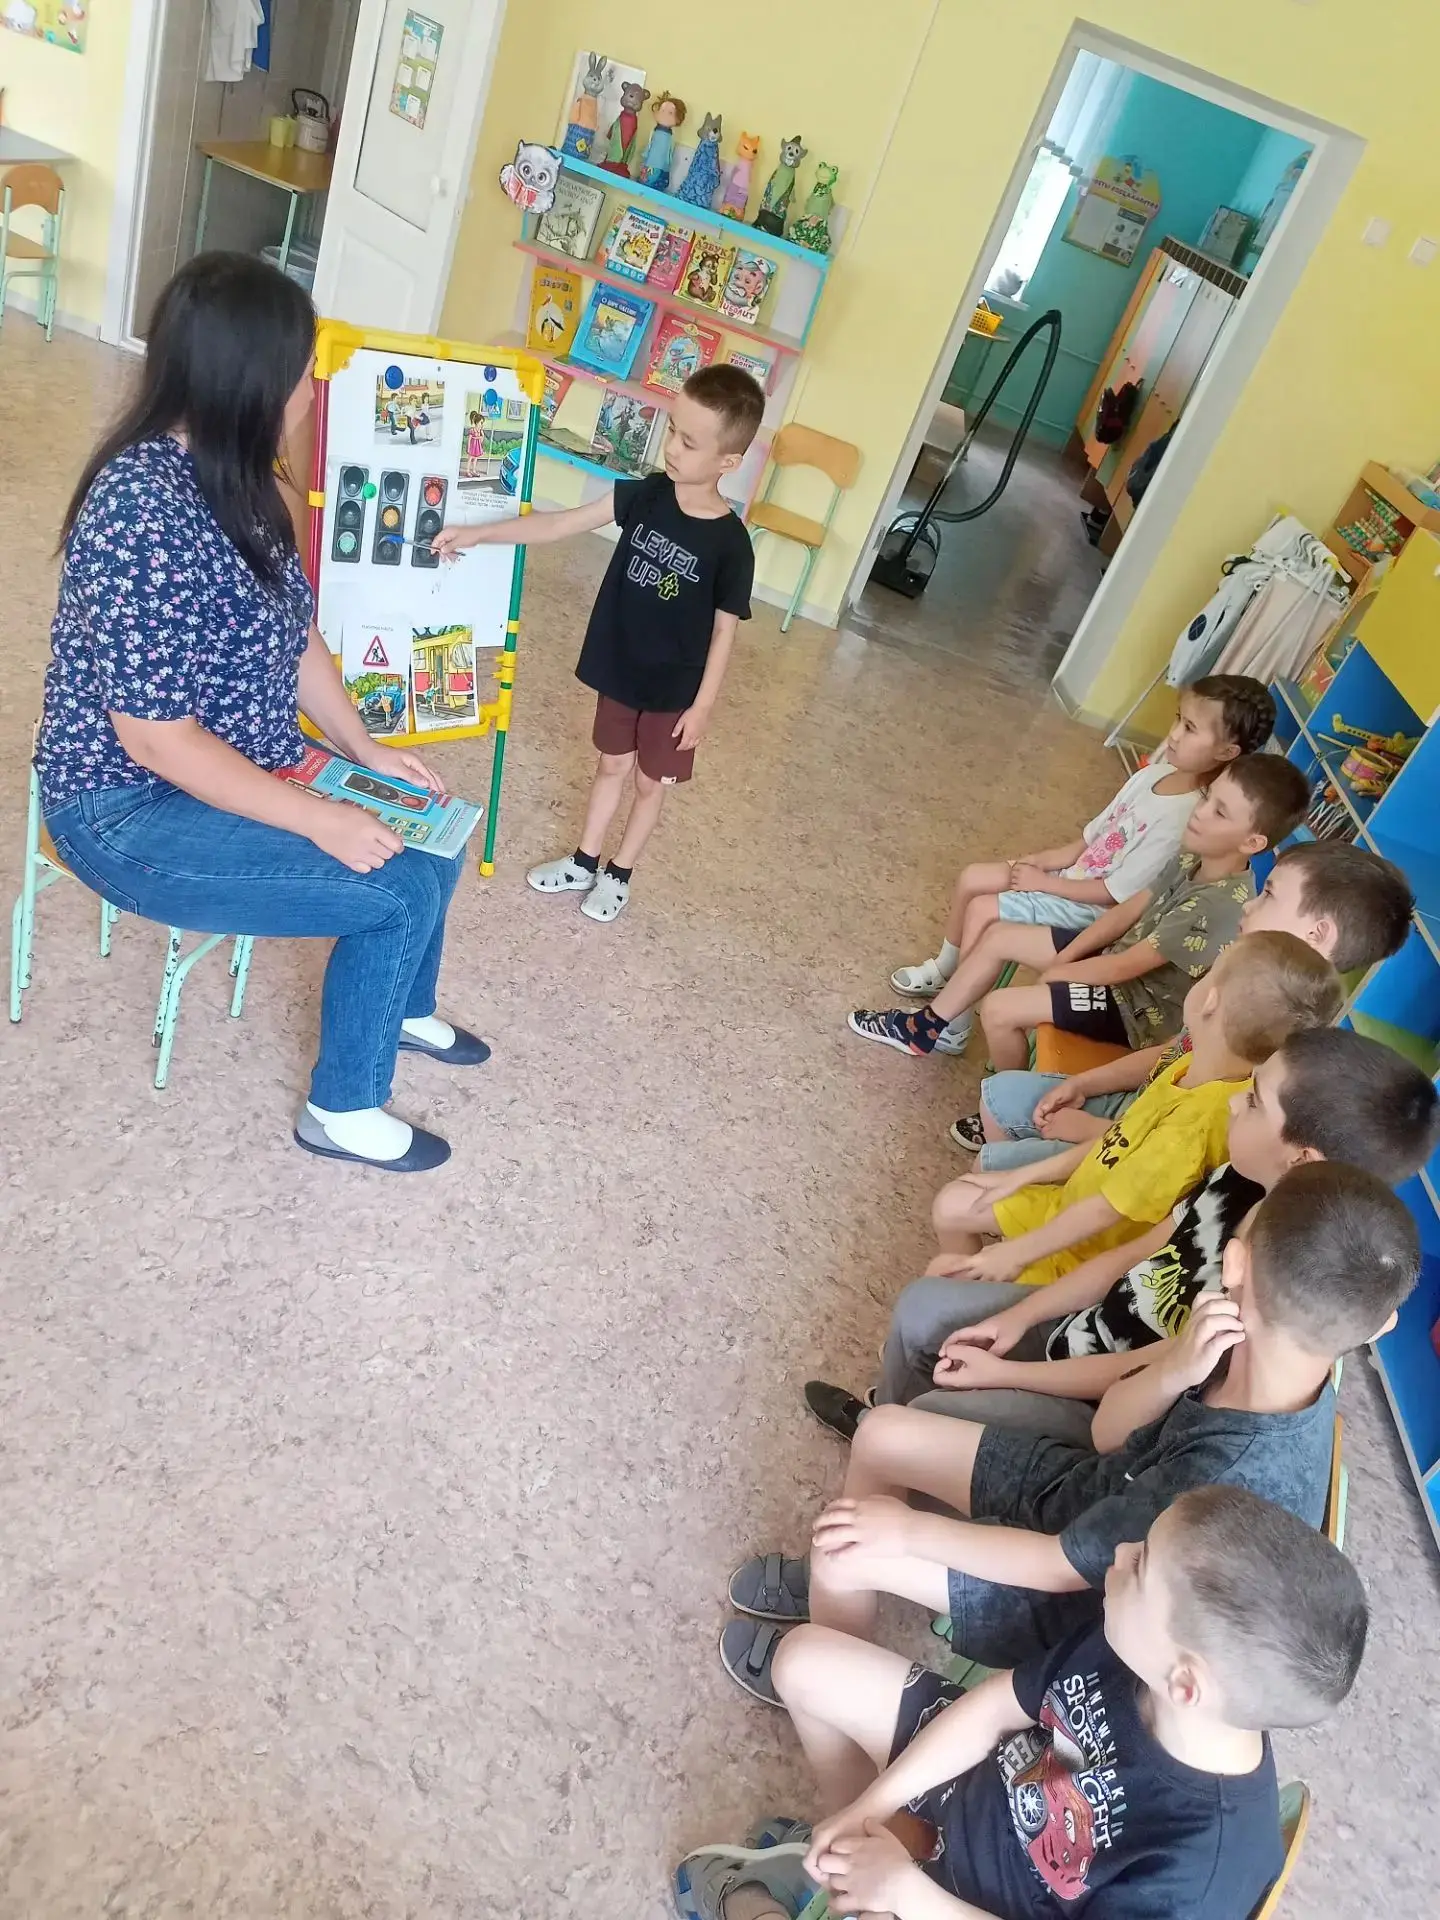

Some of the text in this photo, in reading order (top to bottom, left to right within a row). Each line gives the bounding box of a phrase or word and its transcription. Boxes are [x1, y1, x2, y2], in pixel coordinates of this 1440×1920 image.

[627, 555, 661, 587] UP
[631, 523, 700, 582] LEVEL
[1089, 1690, 1111, 1739] NEW
